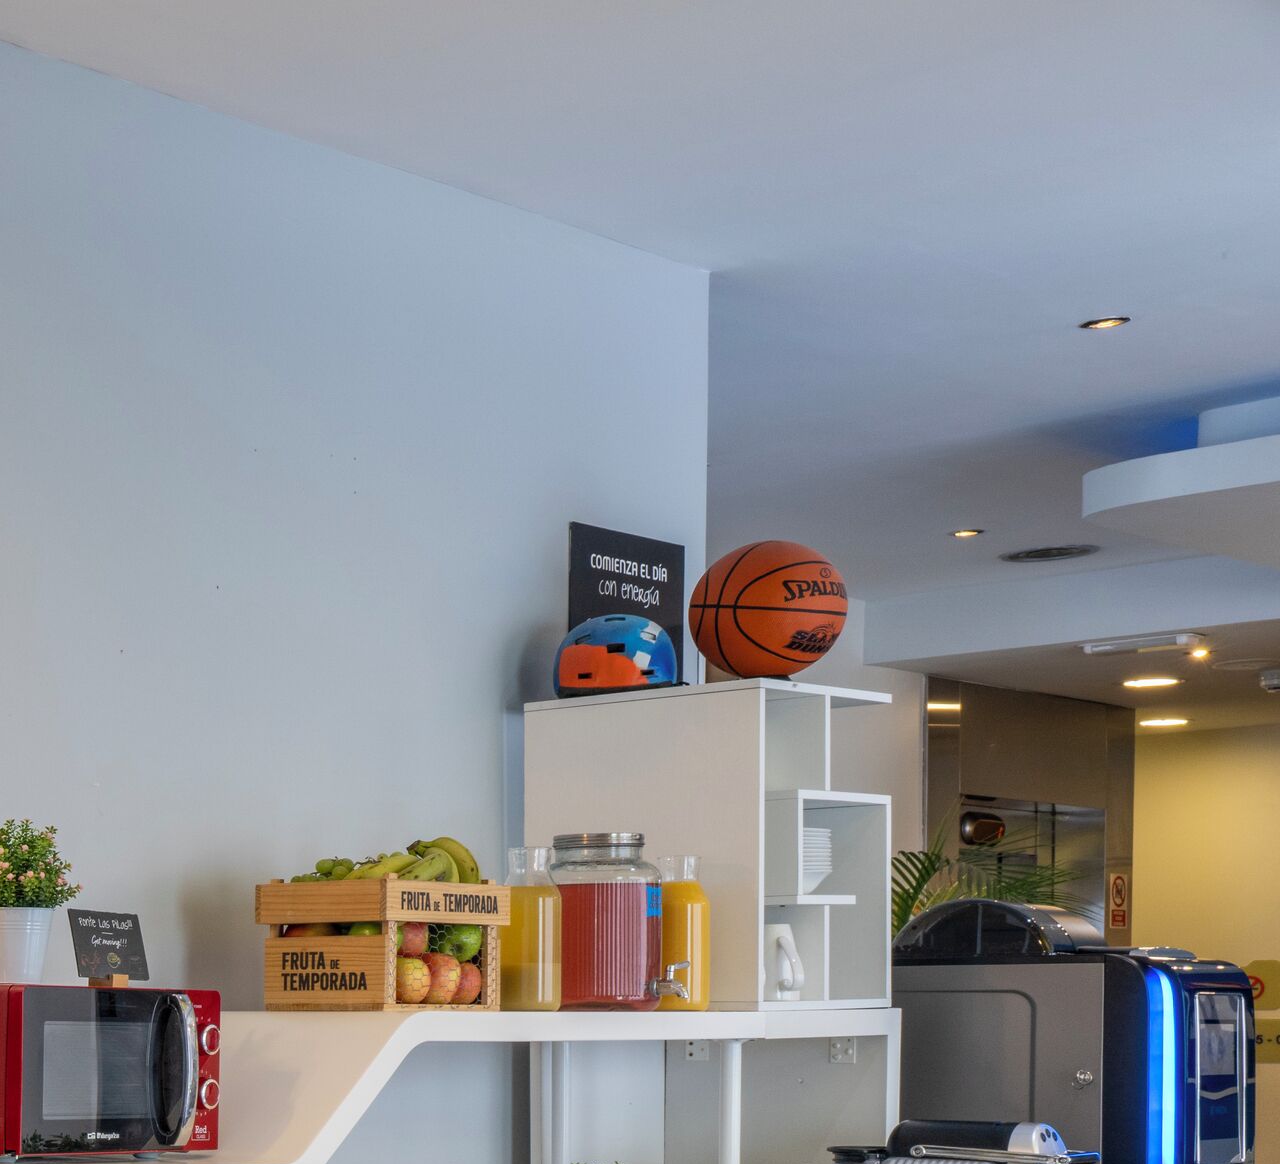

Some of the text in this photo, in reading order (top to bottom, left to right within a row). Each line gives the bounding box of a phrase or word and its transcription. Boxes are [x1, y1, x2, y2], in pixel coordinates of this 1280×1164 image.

[591, 553, 668, 583] COMIENZA EL DÍA
[599, 579, 660, 608] con energía
[401, 891, 498, 914] FRUTA DE TEMPORADA
[91, 935, 101, 947] Get
[281, 952, 340, 970] FRUTA DE
[281, 972, 367, 991] TEMPORADA
[195, 1125, 207, 1134] Red
